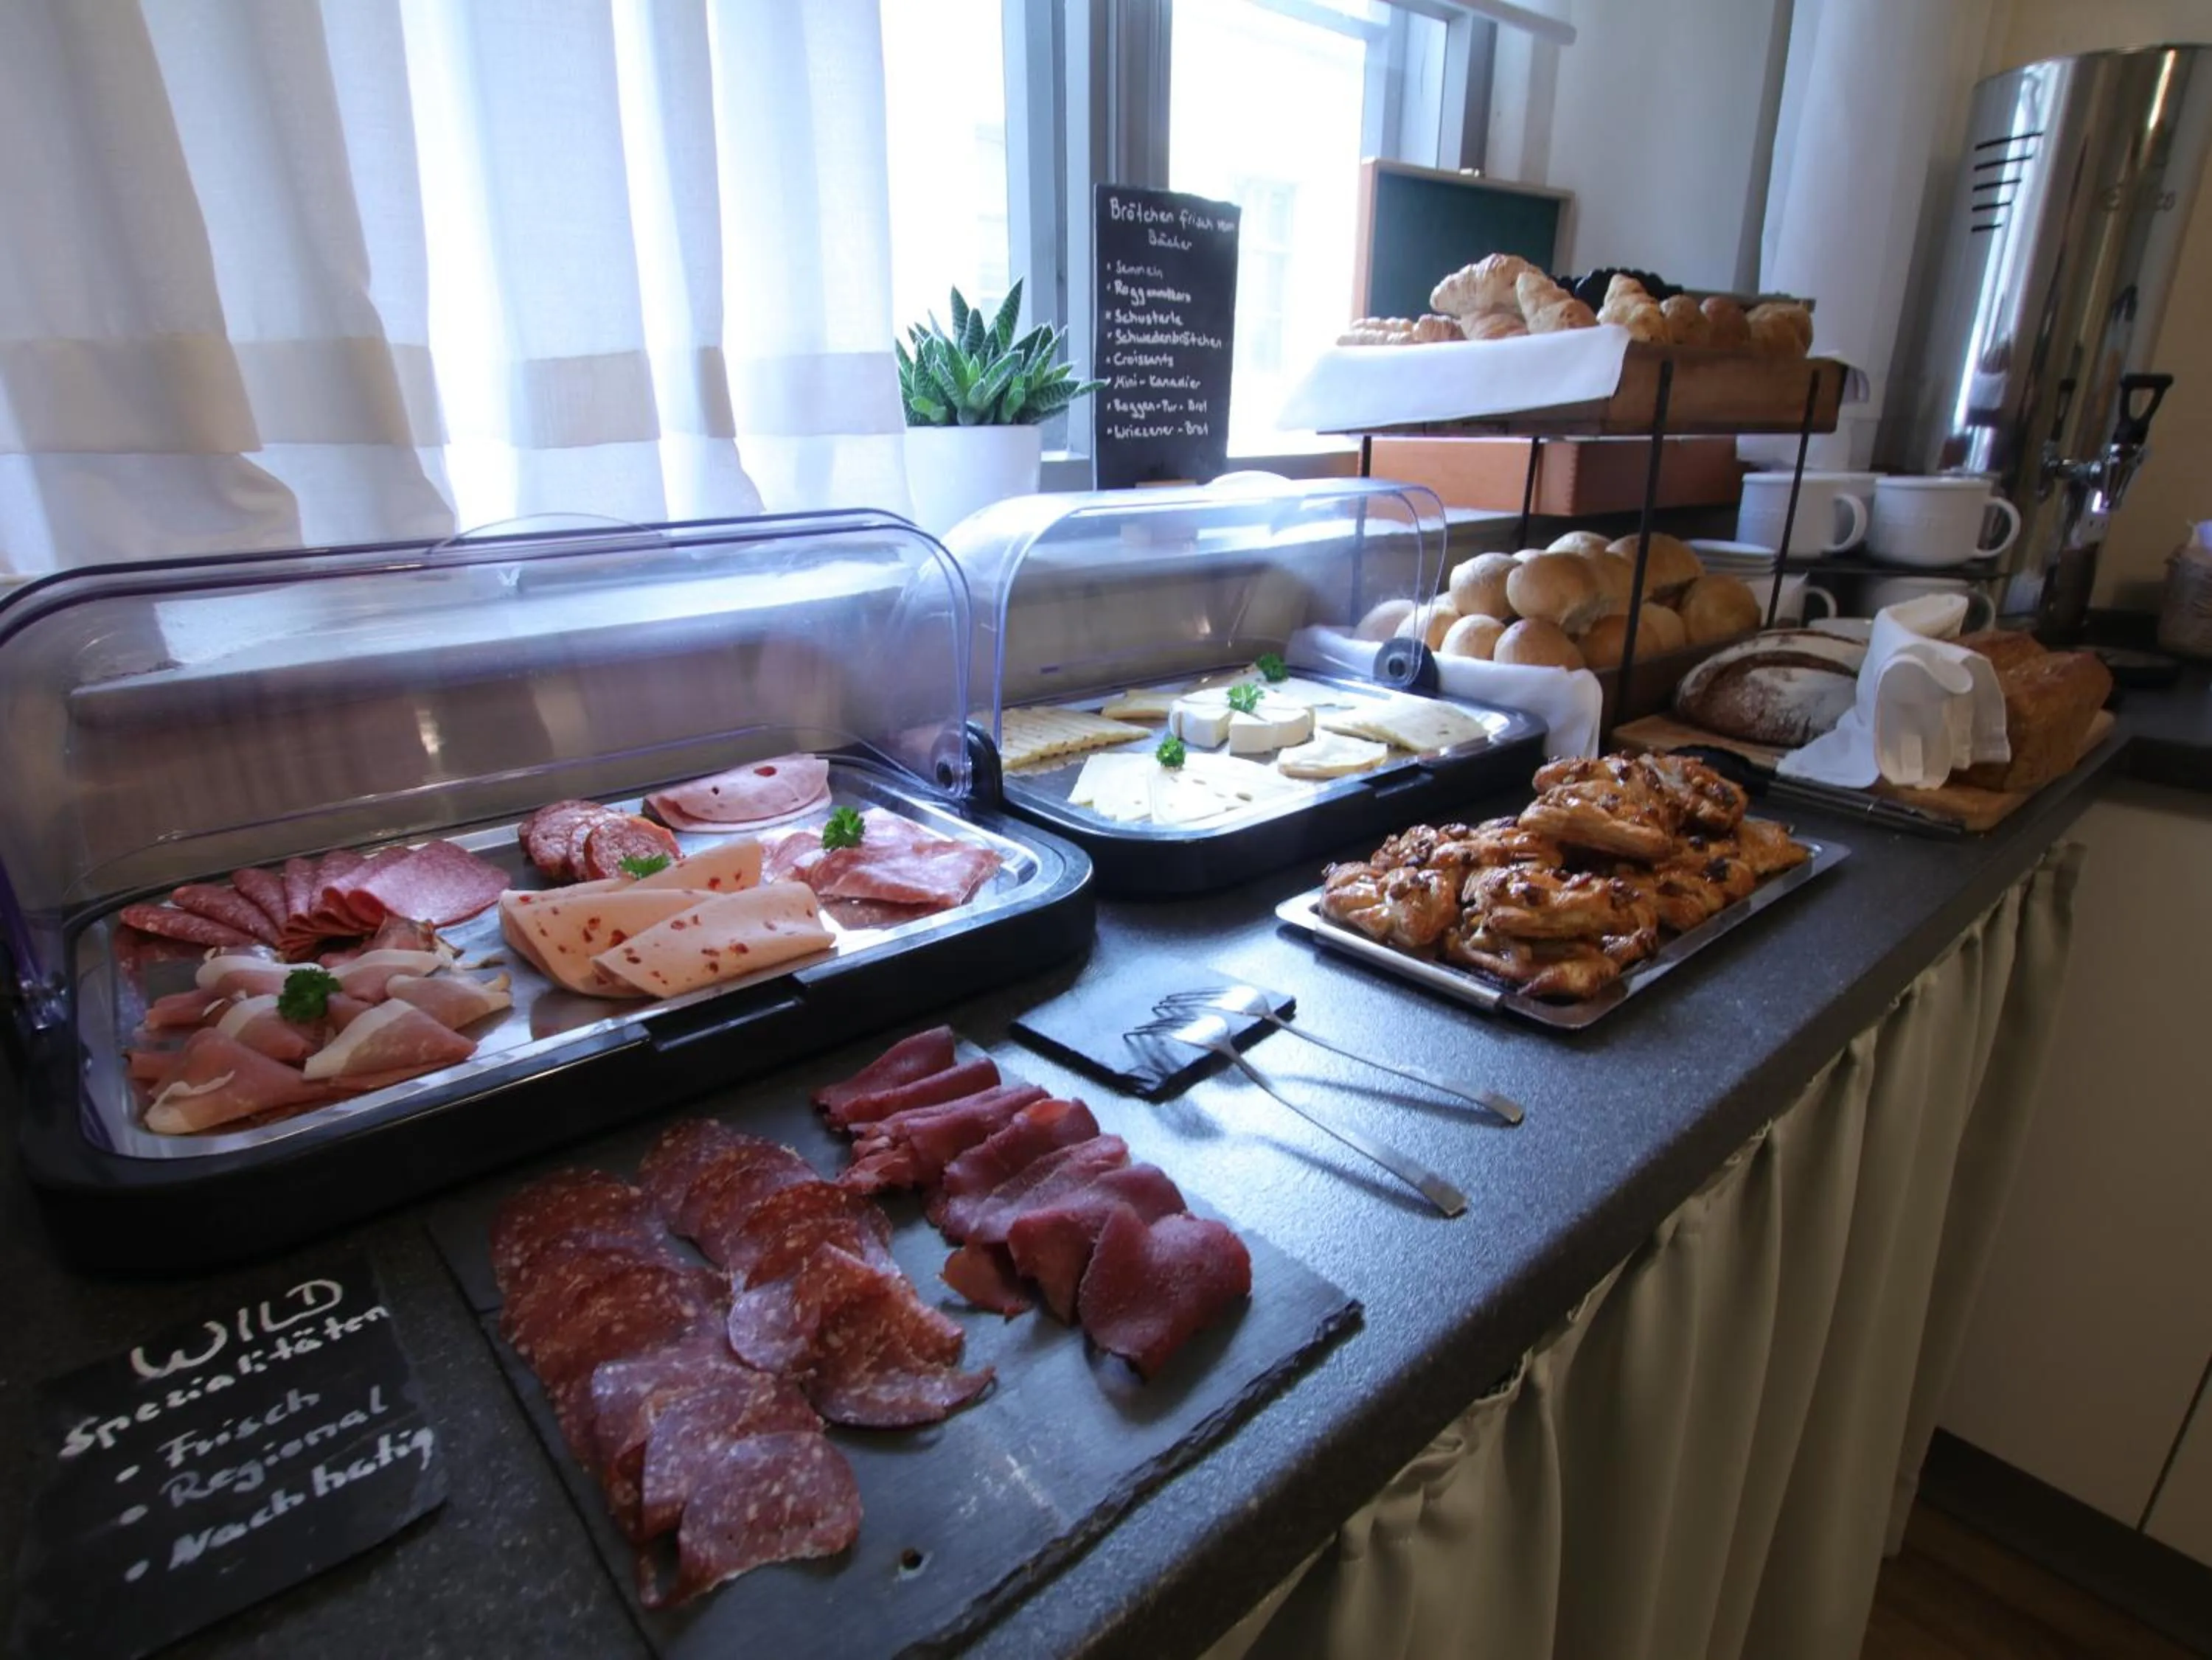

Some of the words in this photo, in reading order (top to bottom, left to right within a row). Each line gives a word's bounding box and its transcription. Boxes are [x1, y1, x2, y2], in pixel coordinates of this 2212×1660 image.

[1179, 209, 1214, 230] frisch
[130, 1279, 344, 1378] WILD
[156, 1387, 320, 1468] Frisch
[159, 1385, 389, 1508] Regional
